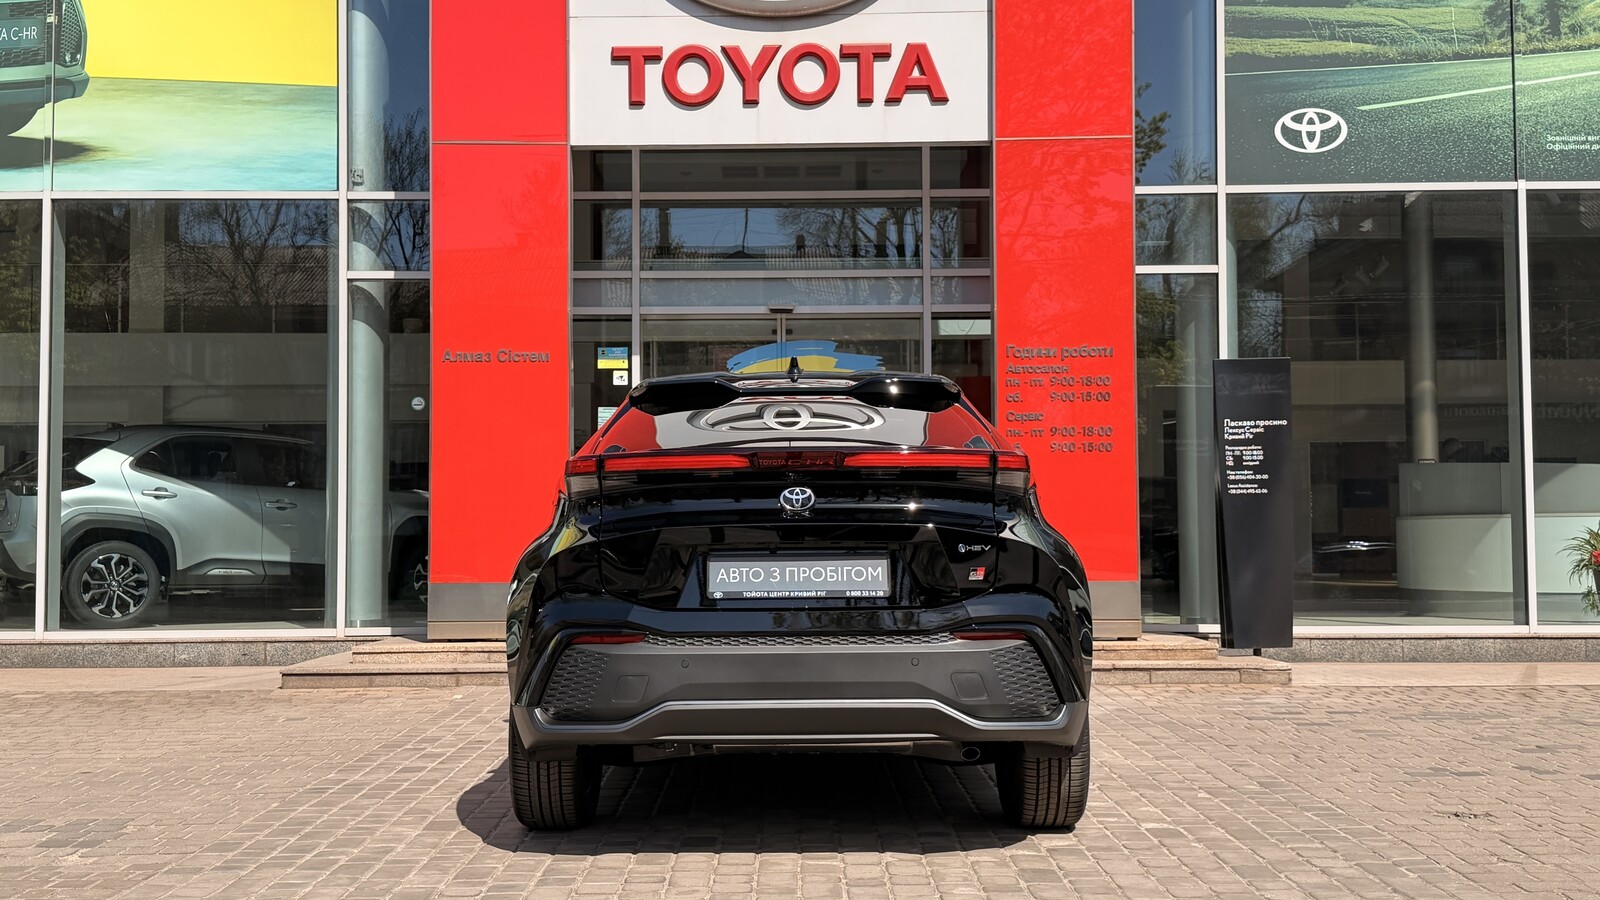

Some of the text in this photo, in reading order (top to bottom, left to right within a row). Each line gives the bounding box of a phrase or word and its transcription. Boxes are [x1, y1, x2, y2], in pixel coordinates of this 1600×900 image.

[10, 26, 38, 41] C-HR
[611, 42, 949, 106] TOYOTA
[442, 348, 550, 363] Алмаз Сістем
[1005, 344, 1114, 361] Години роботи
[1005, 363, 1070, 374] Автосалон
[1049, 376, 1112, 387] 9:00-18:00
[1049, 391, 1112, 403] 9:00-15:00
[1006, 410, 1044, 424] Сервіс
[1224, 418, 1288, 427] Ласкаво просимо
[1049, 426, 1113, 437] 9:00-18:00
[1049, 442, 1113, 453] 9:00-15:00
[716, 567, 765, 583] АВТО
[785, 566, 883, 582] ПРОБІГОМ
[742, 590, 769, 598] ТОЙОТА
[769, 590, 790, 598] ЦЕНТР
